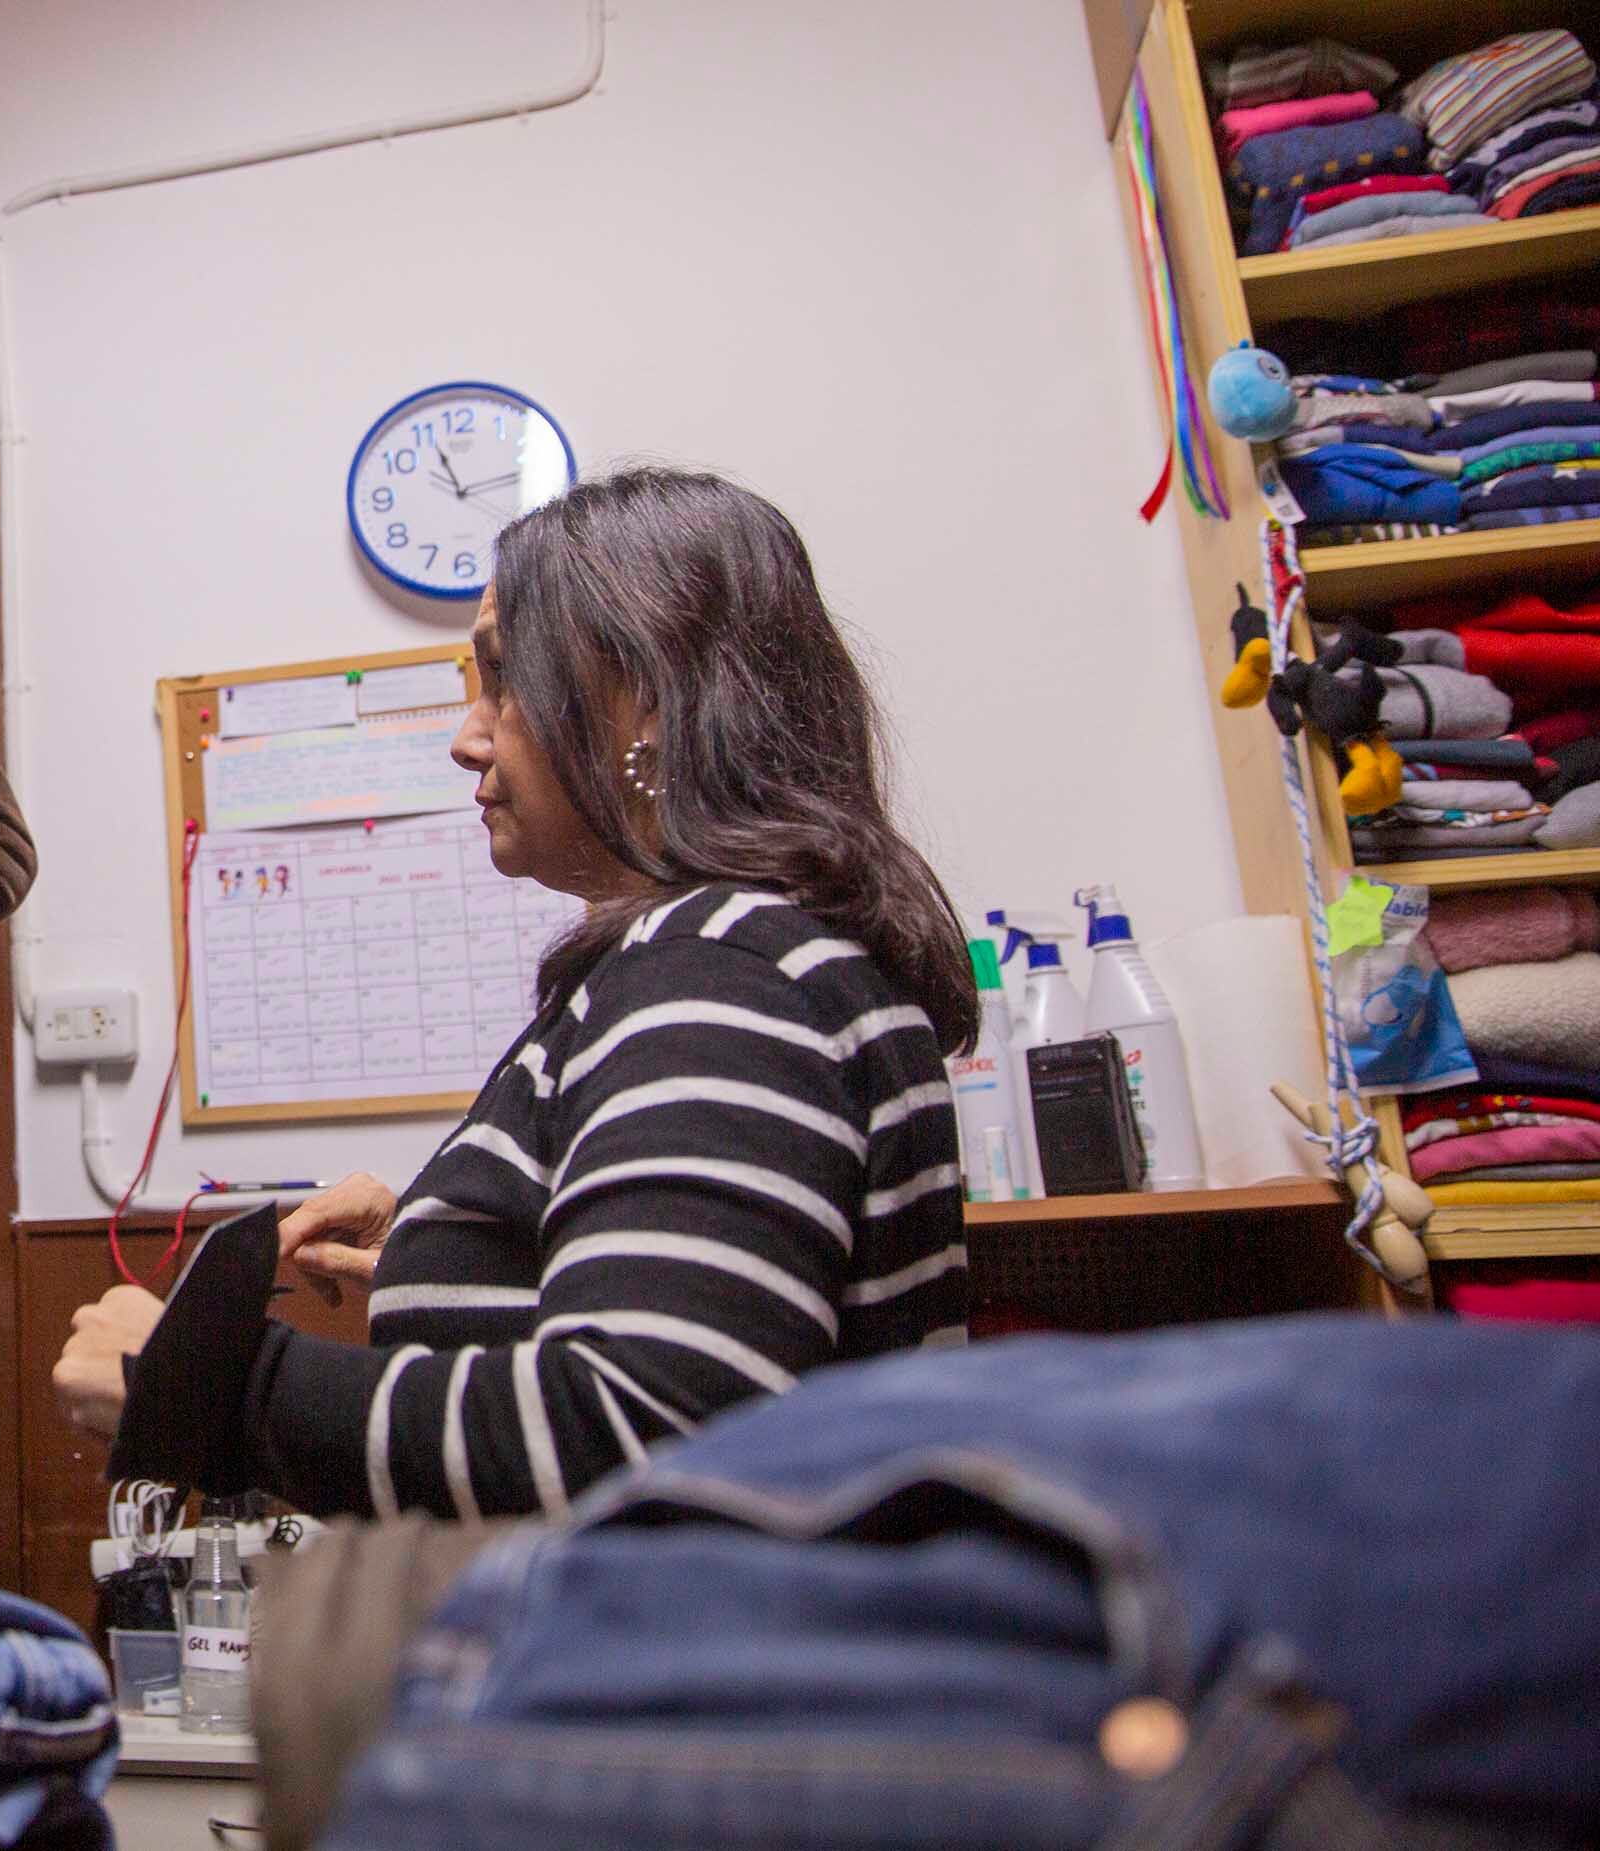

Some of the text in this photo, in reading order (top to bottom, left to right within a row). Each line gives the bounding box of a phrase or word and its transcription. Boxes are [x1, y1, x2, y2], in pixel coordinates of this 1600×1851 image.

[442, 408, 476, 433] 12
[412, 423, 436, 447] 11
[383, 448, 416, 475] 10
[372, 486, 394, 512] 9
[386, 522, 409, 549] 8
[418, 544, 440, 571] 7
[453, 552, 478, 578] 6
[188, 1635, 211, 1652] GEL
